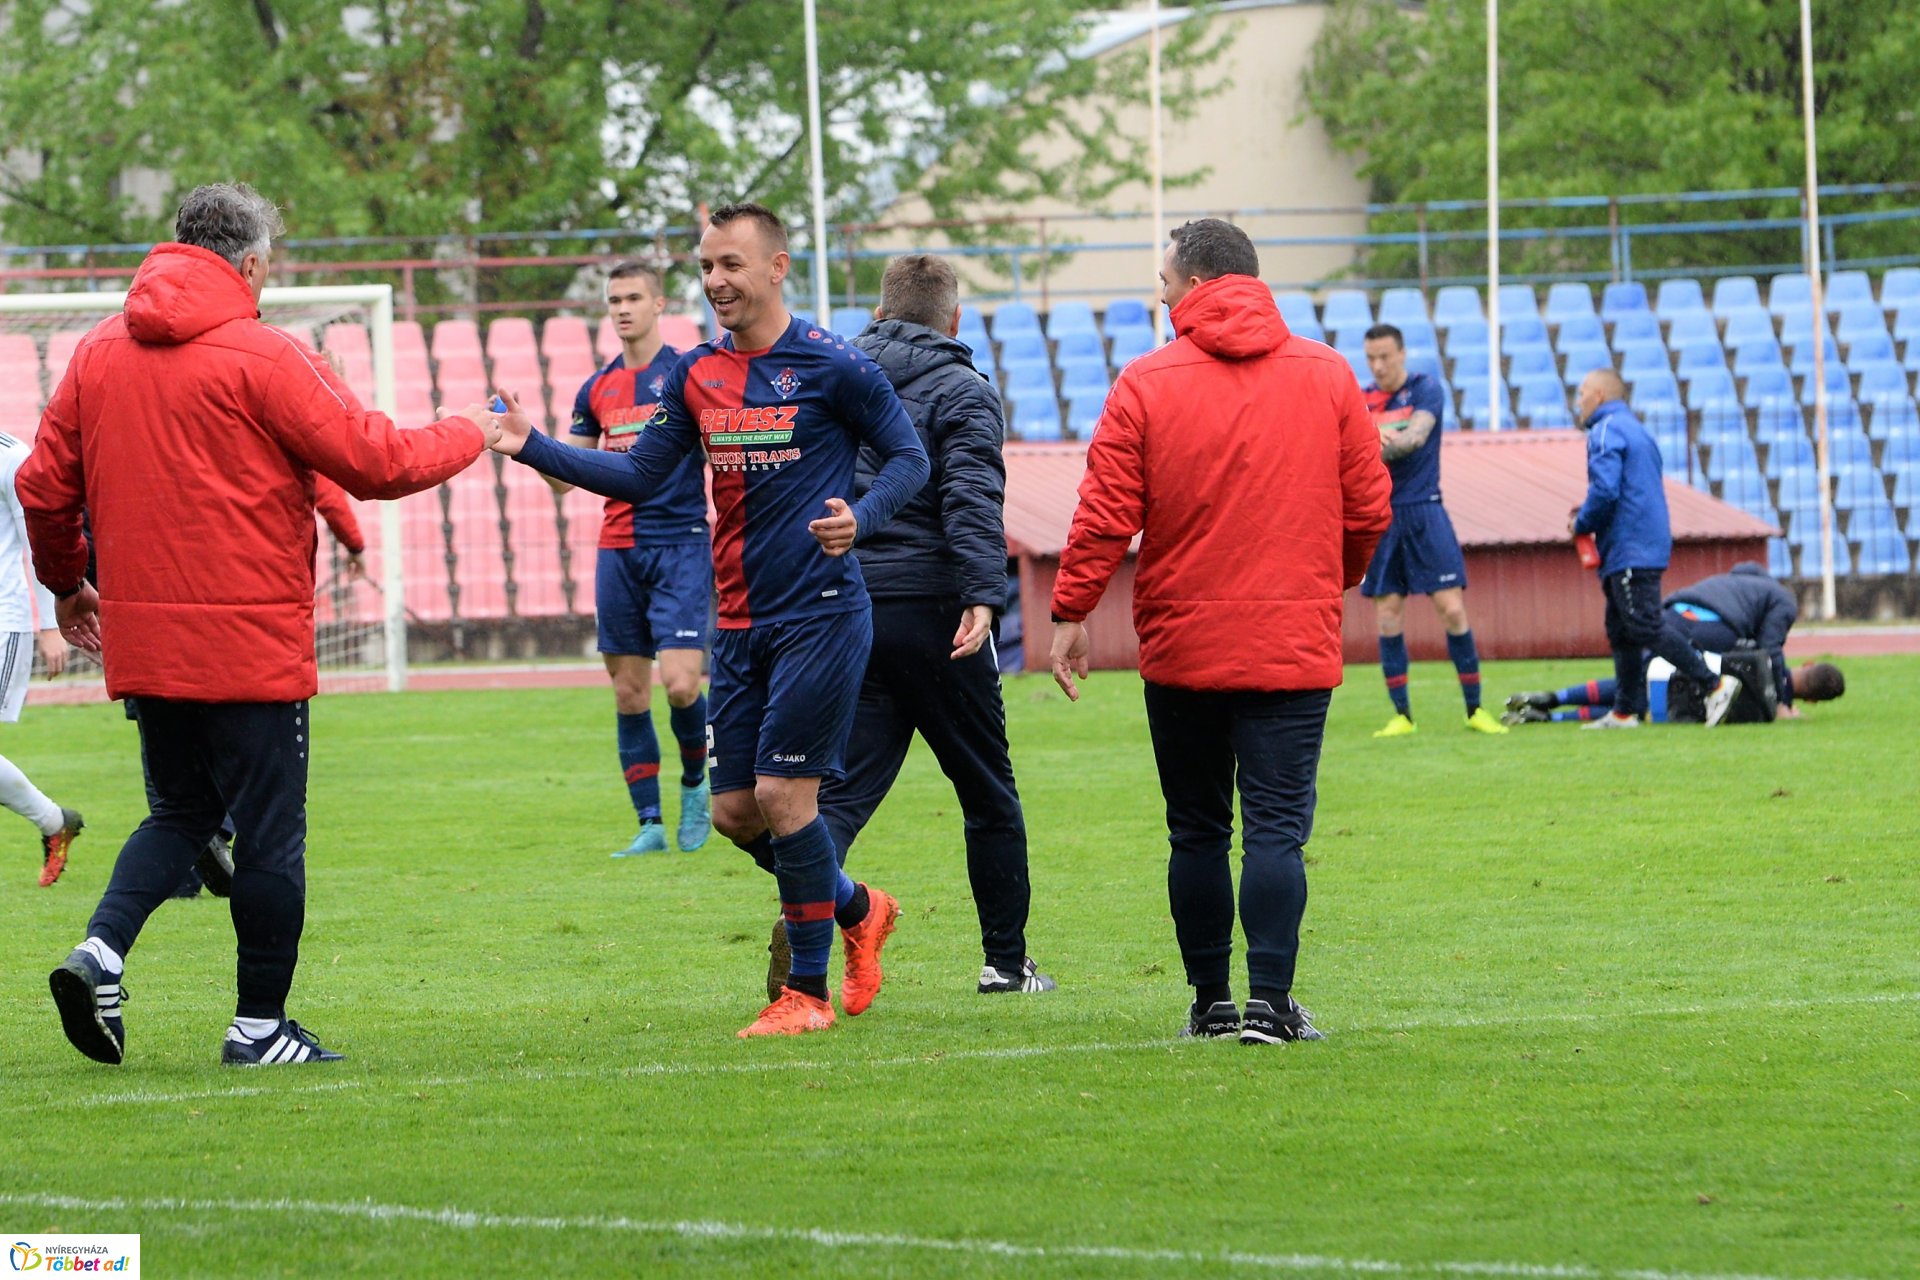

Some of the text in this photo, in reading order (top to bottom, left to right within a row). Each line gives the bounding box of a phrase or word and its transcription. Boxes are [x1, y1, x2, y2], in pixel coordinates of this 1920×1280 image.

[700, 406, 799, 433] REVESZ
[709, 447, 801, 465] RTON TRANS
[783, 754, 806, 763] JAKO
